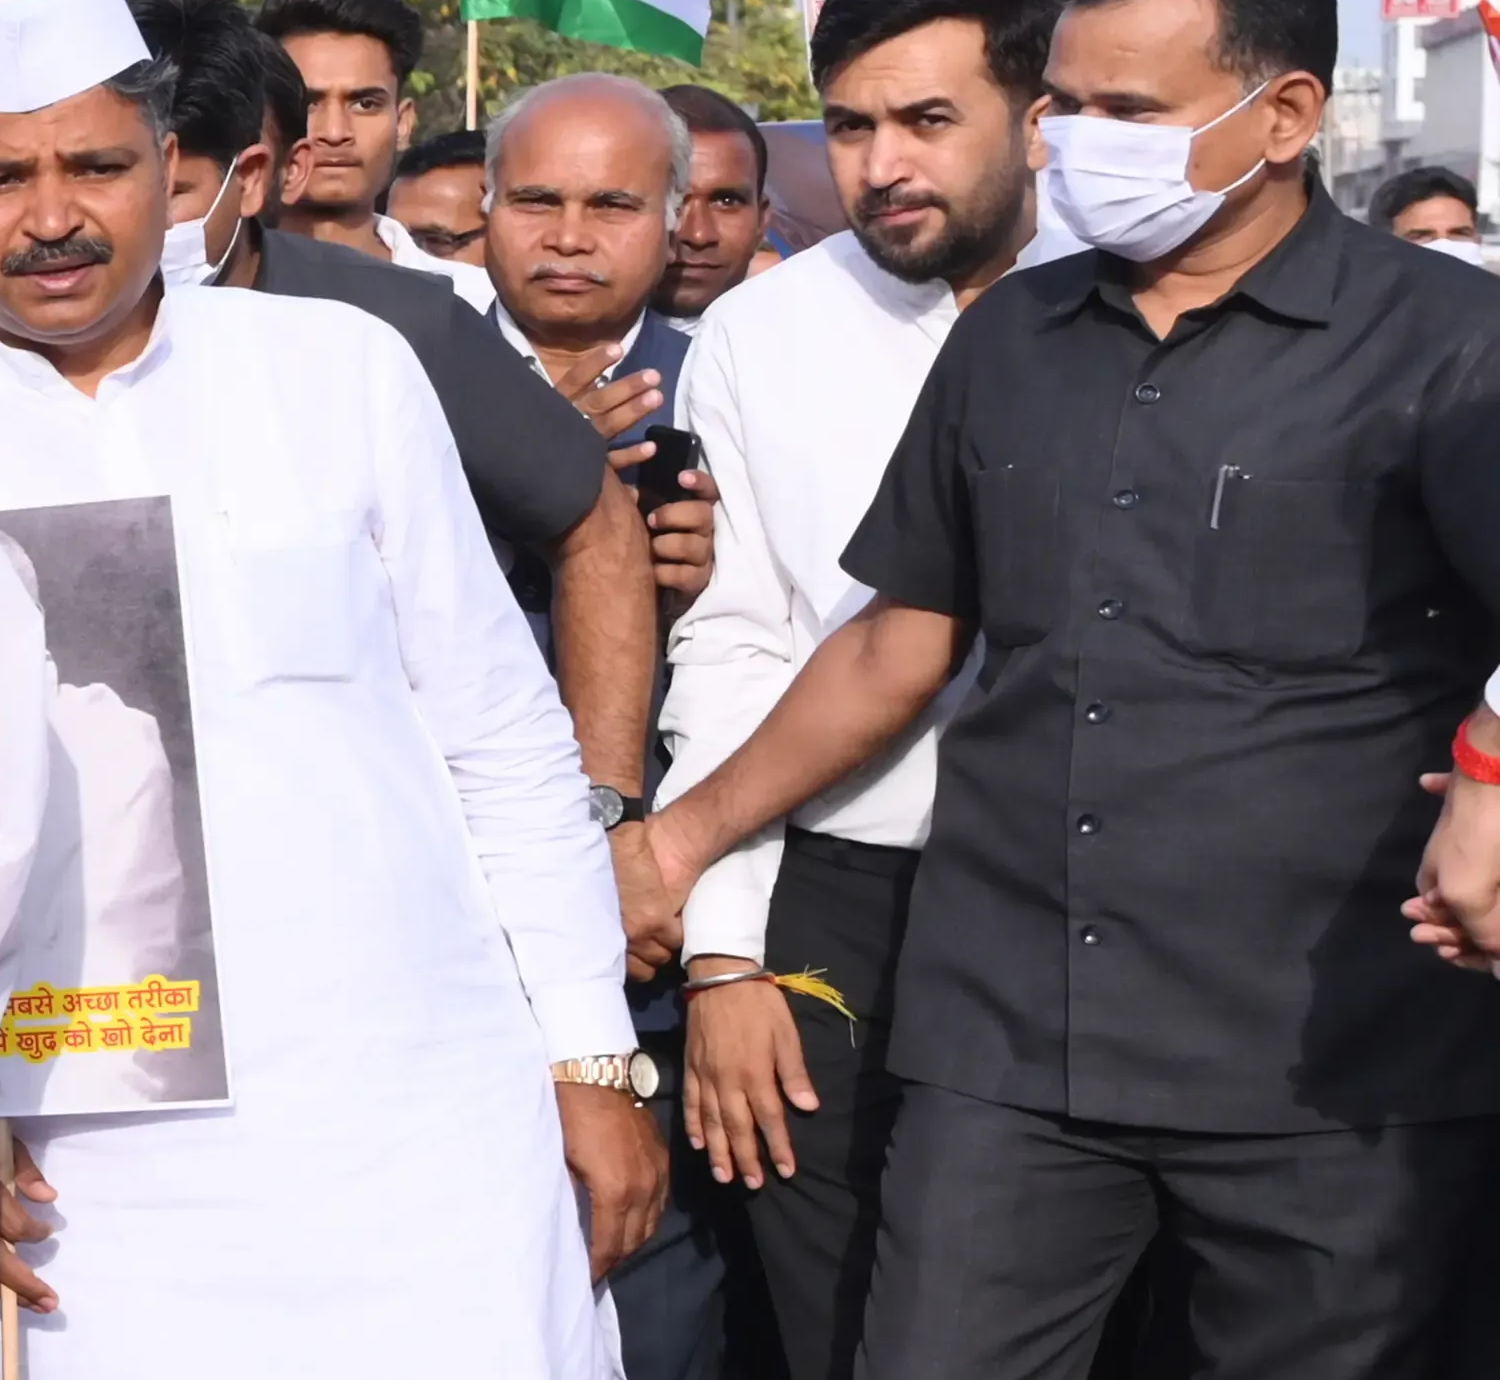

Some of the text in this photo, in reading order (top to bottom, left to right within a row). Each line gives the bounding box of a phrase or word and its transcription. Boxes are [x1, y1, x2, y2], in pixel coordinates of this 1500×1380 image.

[62, 991, 120, 1013] अच्छा
[126, 980, 192, 1009] तरीका
[16, 1029, 58, 1060] खुद
[63, 1019, 93, 1049] को
[101, 1017, 135, 1047] खो
[140, 1016, 185, 1047] देना
